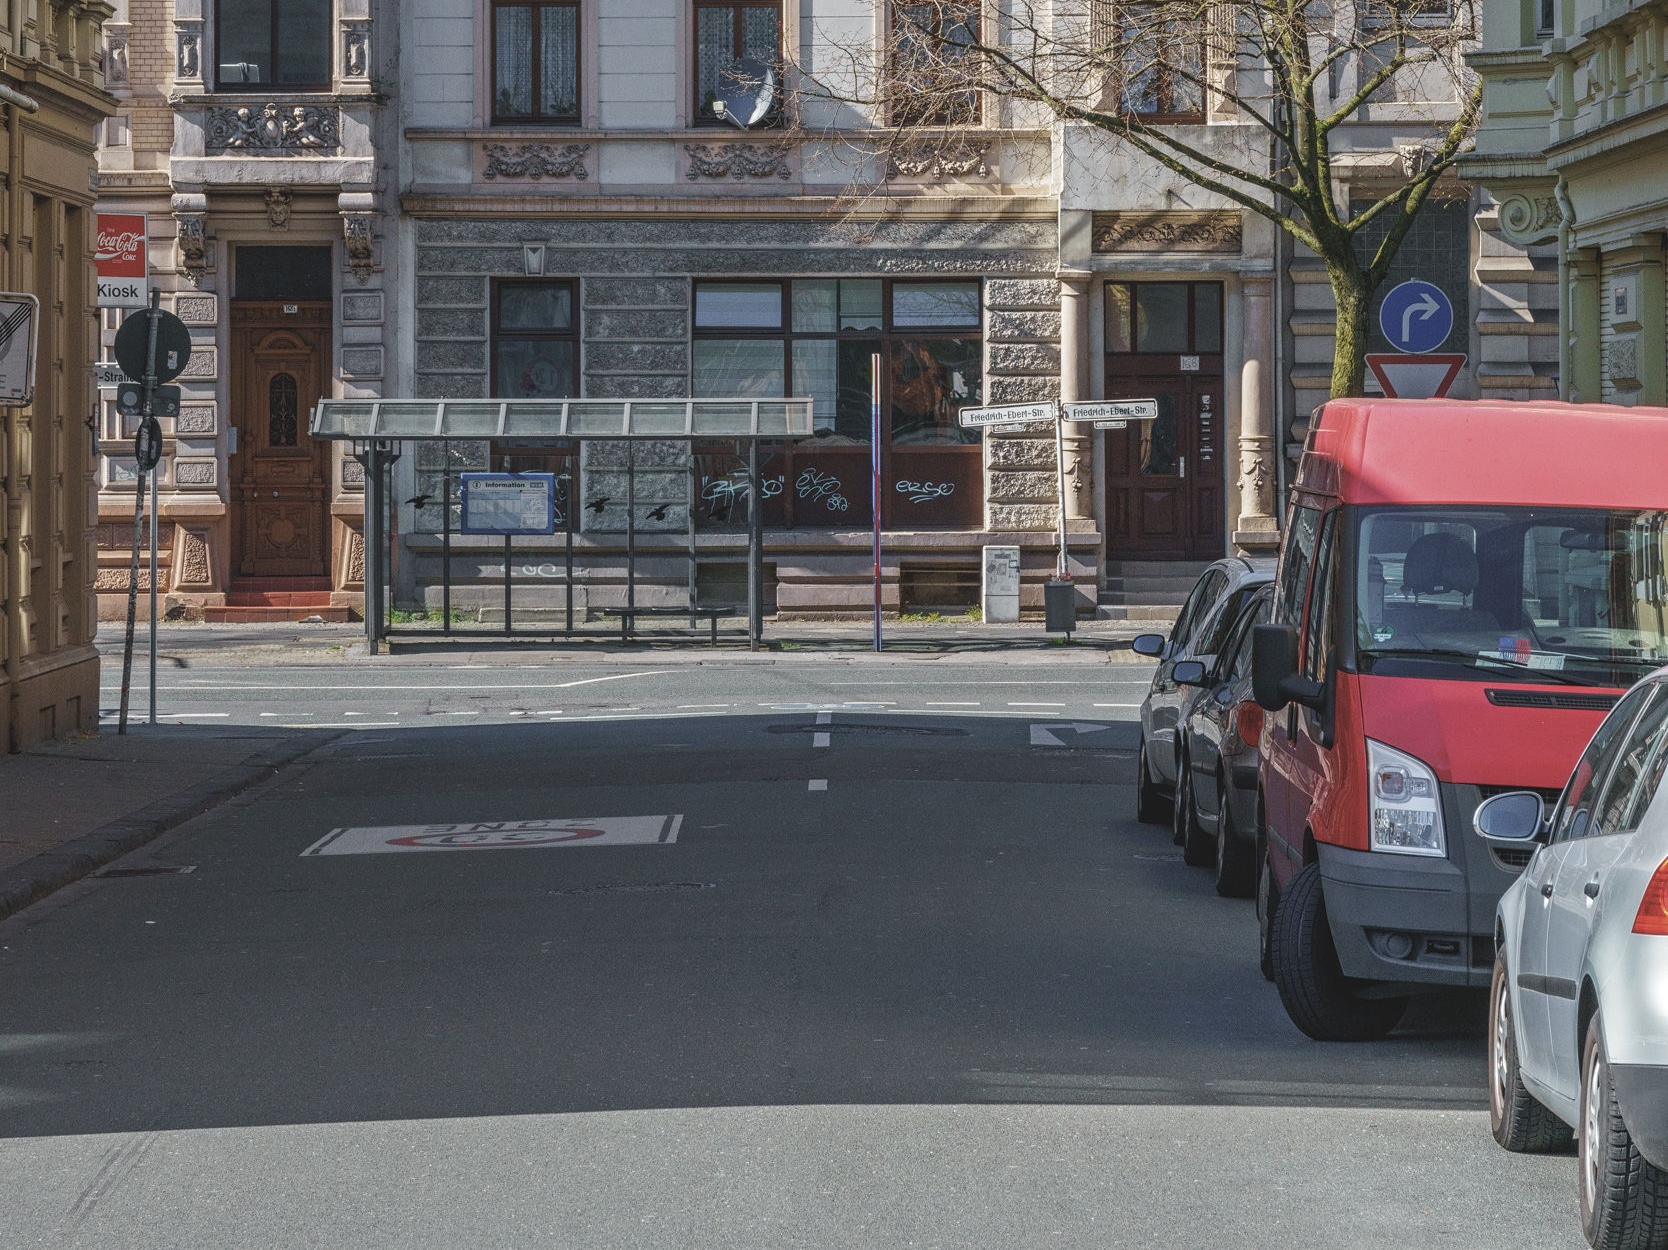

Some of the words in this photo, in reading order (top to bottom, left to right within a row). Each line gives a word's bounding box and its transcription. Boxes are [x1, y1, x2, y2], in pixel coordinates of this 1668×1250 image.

[98, 231, 139, 252] Coca-Cola
[122, 252, 136, 261] Coke
[98, 284, 138, 297] Kiosk
[1182, 357, 1197, 368] 168
[970, 408, 1045, 422] Friedrich-Ebert-Str.
[1073, 406, 1148, 417] Friedrich-Ebert-Str.
[423, 818, 595, 833] ZONE
